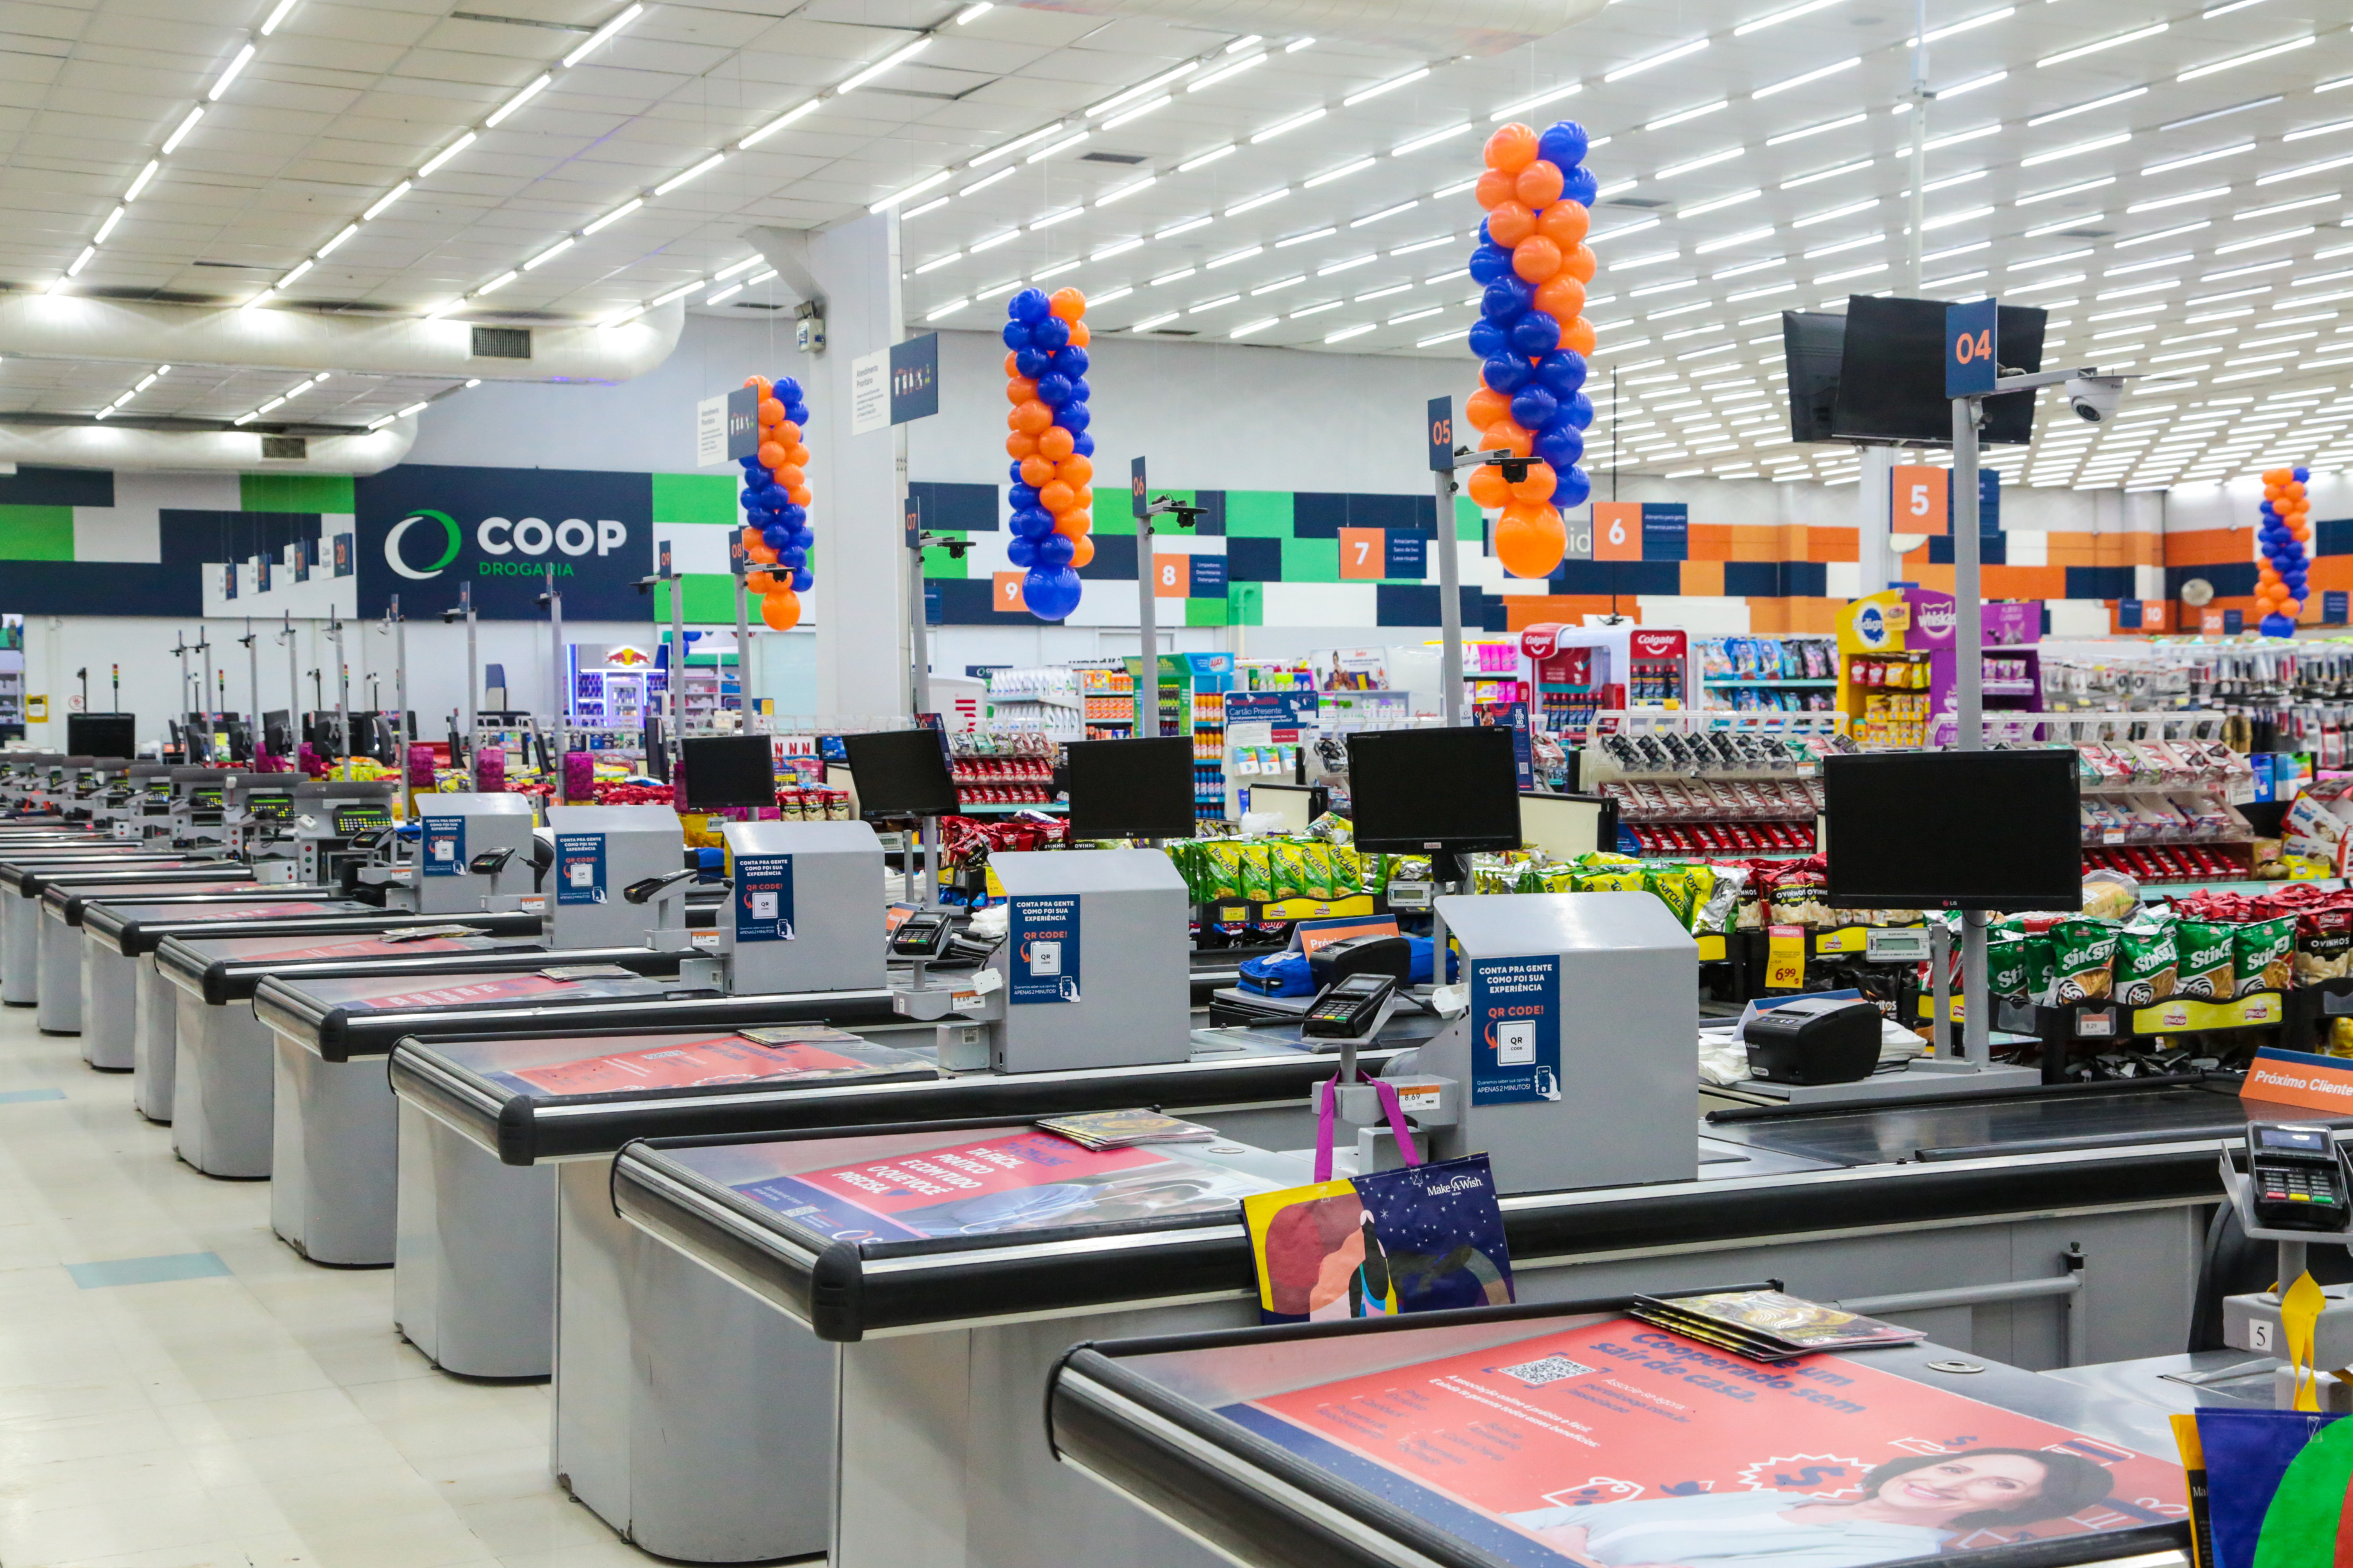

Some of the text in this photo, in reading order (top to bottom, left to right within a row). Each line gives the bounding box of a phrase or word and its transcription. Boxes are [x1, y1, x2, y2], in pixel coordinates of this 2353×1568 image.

[1956, 330, 1992, 365] 04
[1433, 419, 1451, 445] 05
[1134, 476, 1144, 496] 06
[1910, 485, 1930, 516] 5
[907, 513, 916, 530] 07
[1609, 518, 1625, 546] 6
[477, 517, 626, 556] COOP
[660, 552, 671, 567] 09
[732, 543, 742, 558] 08
[1355, 542, 1369, 565] 7
[1162, 565, 1176, 586] 8
[1006, 581, 1018, 601] 9
[2146, 607, 2162, 622] 10
[1526, 635, 1552, 645] Colgate
[1638, 634, 1676, 645] Colgate
[1210, 658, 1223, 668] AJAX
[776, 743, 783, 755] N
[790, 743, 797, 754] N
[802, 742, 810, 754] N
[1211, 846, 1238, 877] Torcida
[1242, 849, 1270, 879] Torcida
[1274, 846, 1301, 877] Torcida
[1303, 846, 1328, 877] Torcida
[1331, 845, 1356, 877] Torcida
[1659, 878, 1684, 914] Torcida
[1777, 889, 1805, 898] OVINHOS
[2311, 937, 2349, 948] OVINHOS
[1479, 966, 1507, 974] CONTA
[1775, 968, 1796, 982] 6,99
[1490, 983, 1542, 993] EXPERIÊNCIA
[1488, 1005, 1543, 1019] QR CODE!
[2254, 1069, 2353, 1097] Próximo Cliente
[932, 1153, 995, 1174] PRÁTICO
[966, 1147, 988, 1160] TÁ
[875, 1168, 911, 1184] QUE
[902, 1177, 955, 1196] VOCÊ
[908, 1162, 944, 1180] COM
[936, 1172, 984, 1190] TUDO
[2256, 1326, 2266, 1346] 5
[1588, 1343, 1757, 1403] sair de casa.
[1631, 1333, 1867, 1414] Cooperado sem
[1796, 1366, 1855, 1387] um
[1454, 1378, 1499, 1397] associação
[1497, 1394, 1525, 1407] online
[1527, 1407, 1562, 1421] prática
[1602, 1378, 1657, 1400] Associe-se
[1436, 1381, 1461, 1393] ainda
[1465, 1393, 1502, 1409] garante
[1500, 1406, 1527, 1419] todos
[1525, 1416, 1552, 1428] esses
